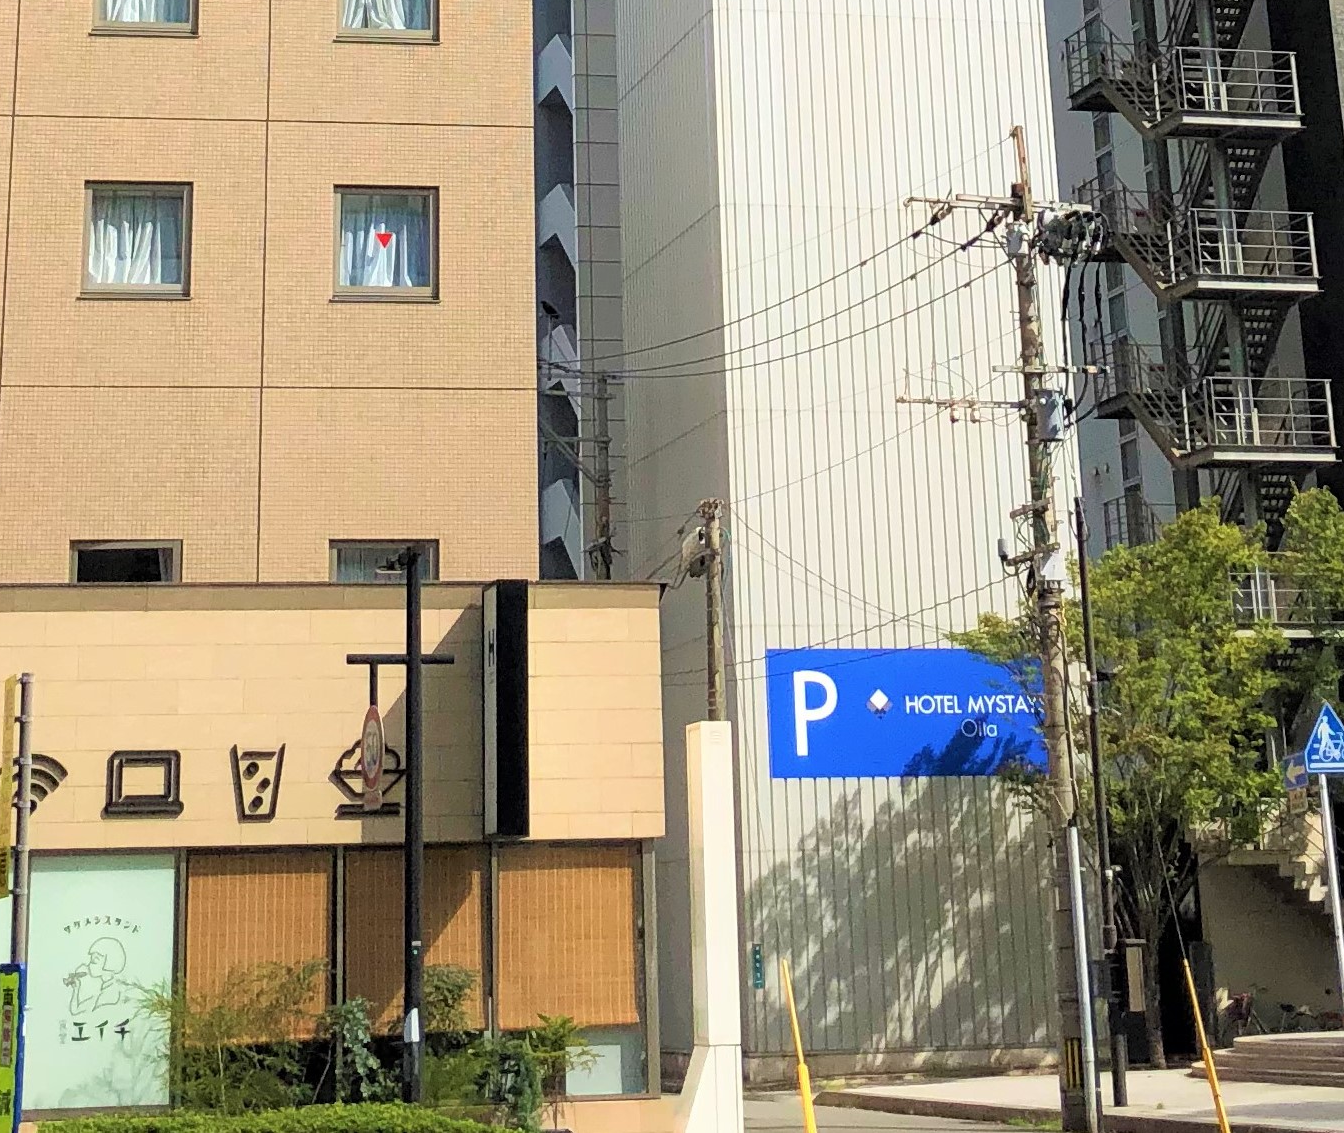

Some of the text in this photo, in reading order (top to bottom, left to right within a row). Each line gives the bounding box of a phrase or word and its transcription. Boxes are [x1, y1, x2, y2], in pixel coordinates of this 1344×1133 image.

[793, 669, 838, 756] P
[906, 695, 962, 714] HOTEL
[71, 1018, 131, 1042] エイチ
